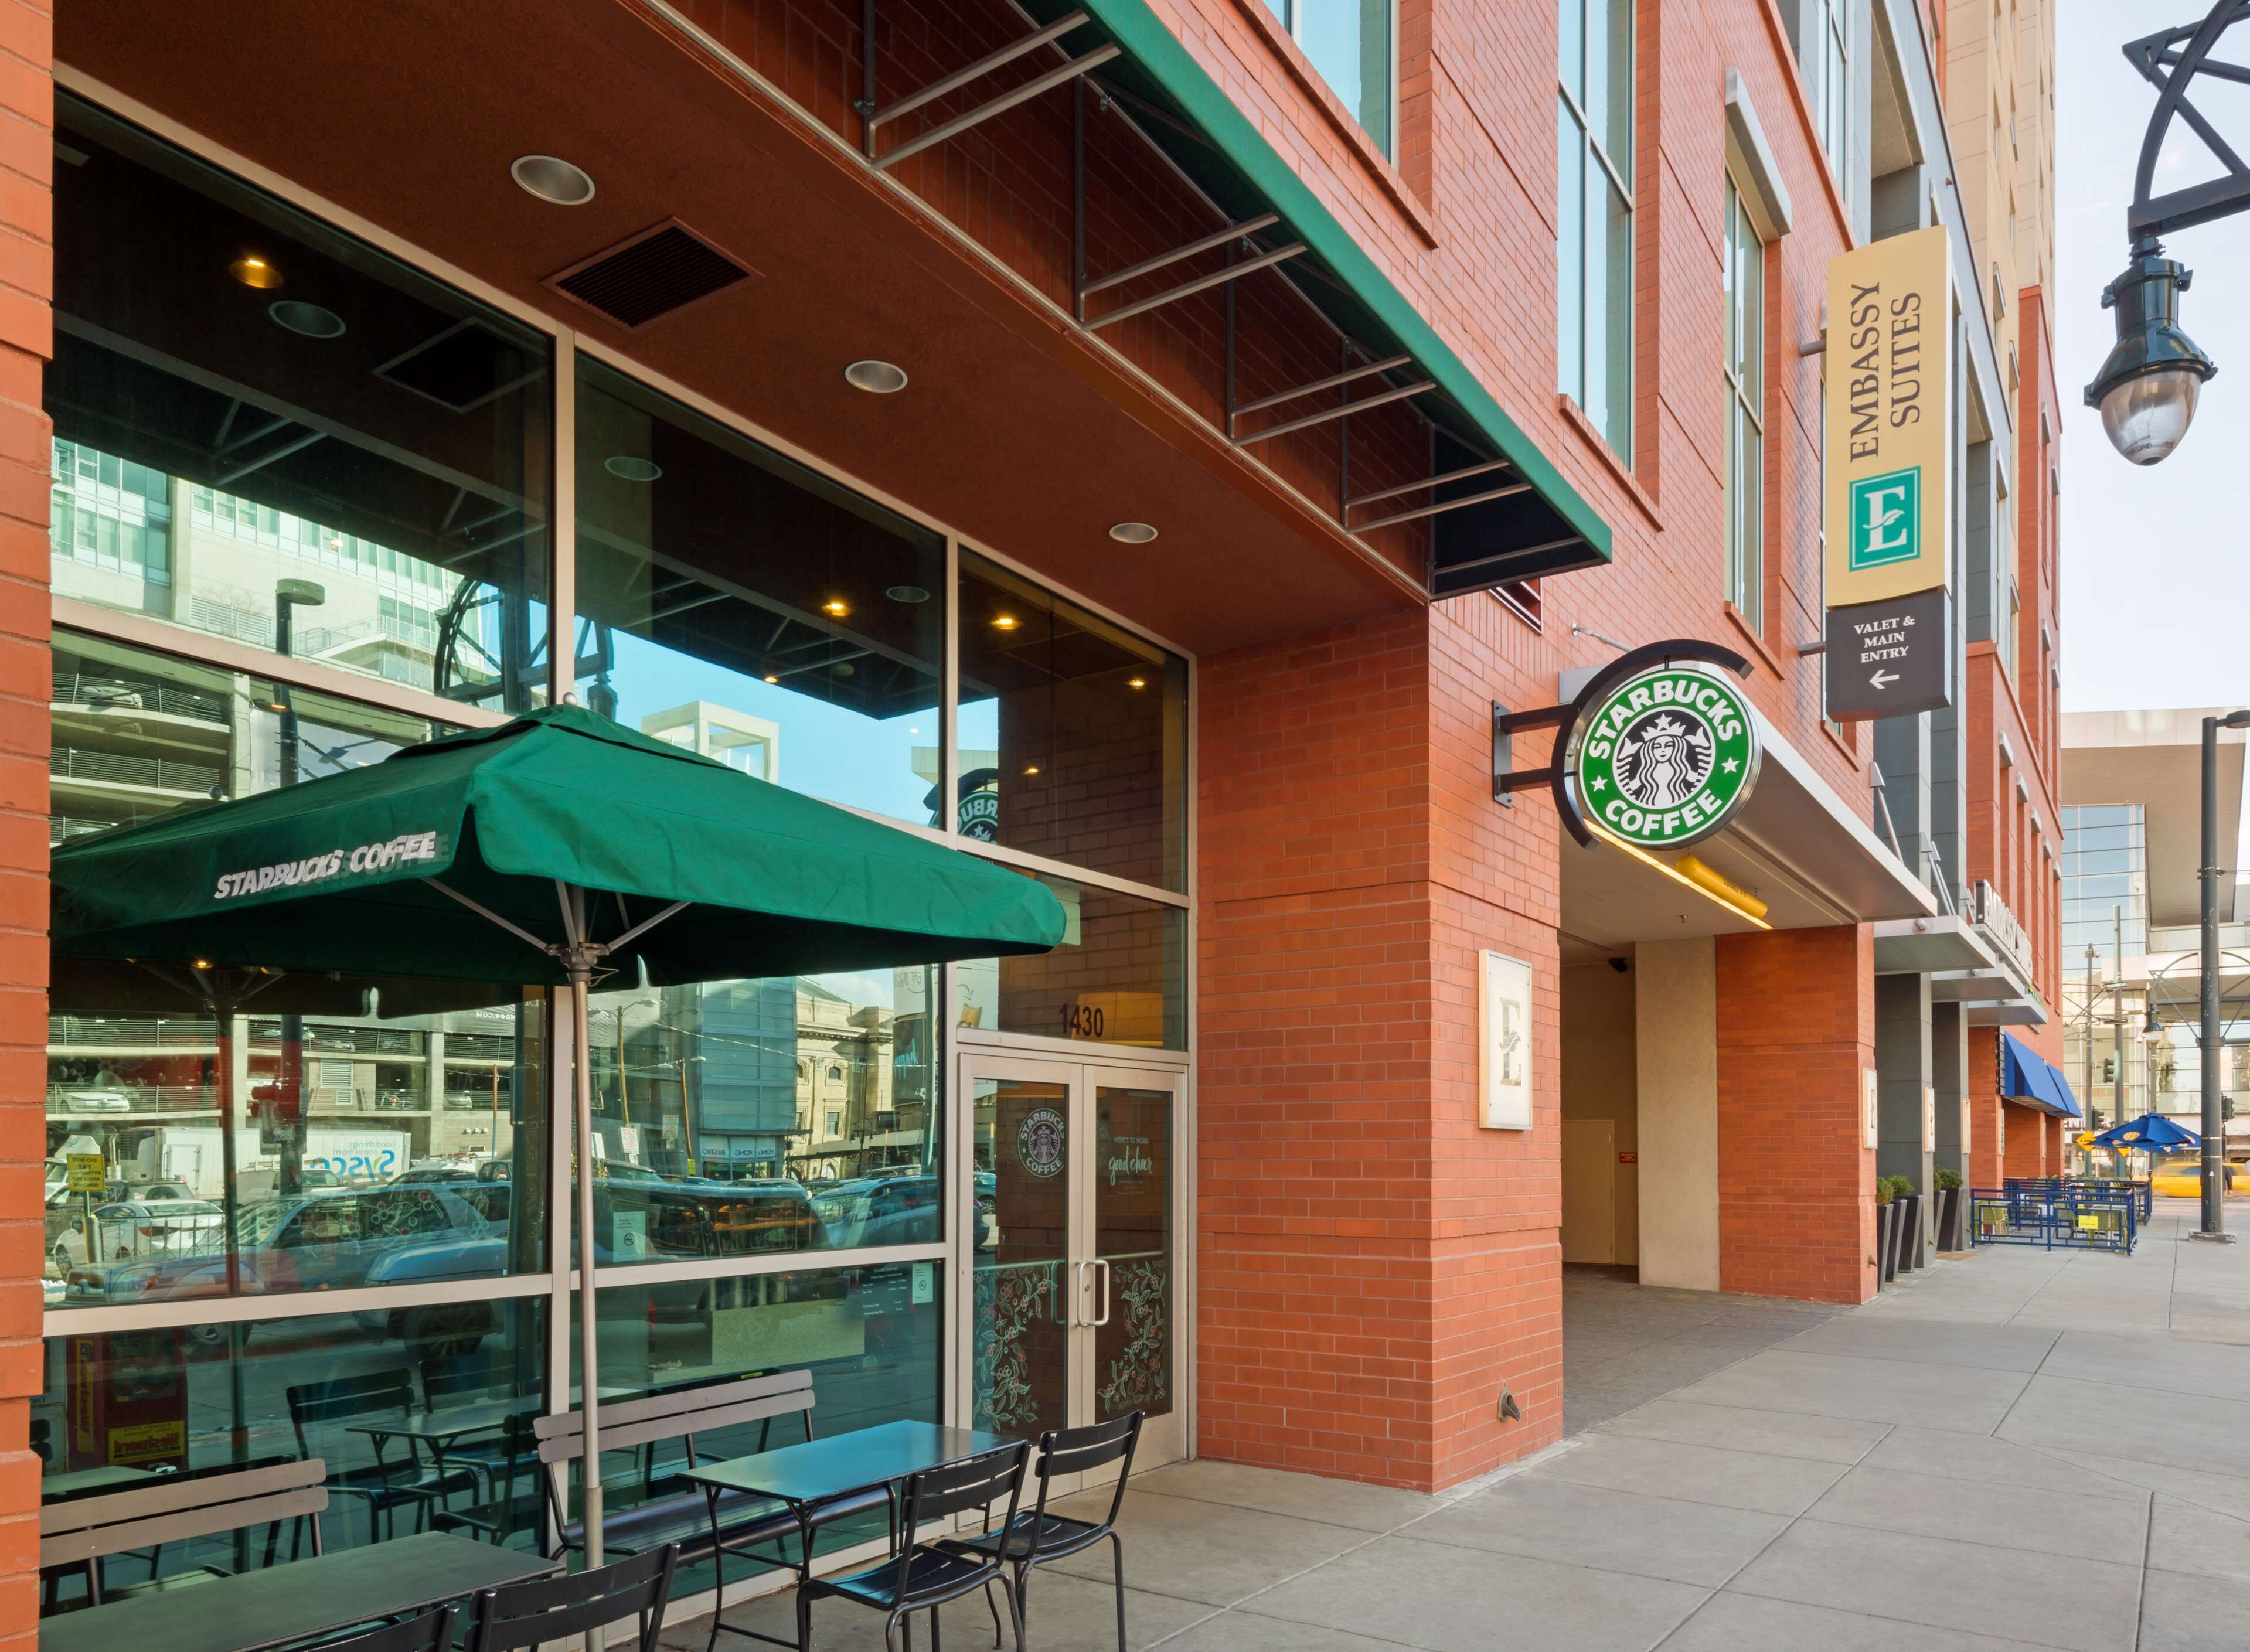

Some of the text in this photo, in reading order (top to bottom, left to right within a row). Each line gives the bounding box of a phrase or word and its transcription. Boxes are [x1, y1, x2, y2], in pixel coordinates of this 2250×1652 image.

[1850, 282, 1880, 463] EMBASSY
[1890, 292, 1921, 427] SUITES
[1854, 616, 1915, 634] VALET &
[1864, 632, 1905, 648] MAIN
[1861, 646, 1909, 663] ENTRY
[1589, 680, 1741, 759] STARBUCKS
[1605, 789, 1723, 836] COFFEE
[214, 831, 436, 899] STARBUCKS COFFEE
[1059, 1003, 1104, 1037] 1430
[1026, 1157, 1062, 1174] COFFEE
[1109, 1145, 1153, 1186] good cheer
